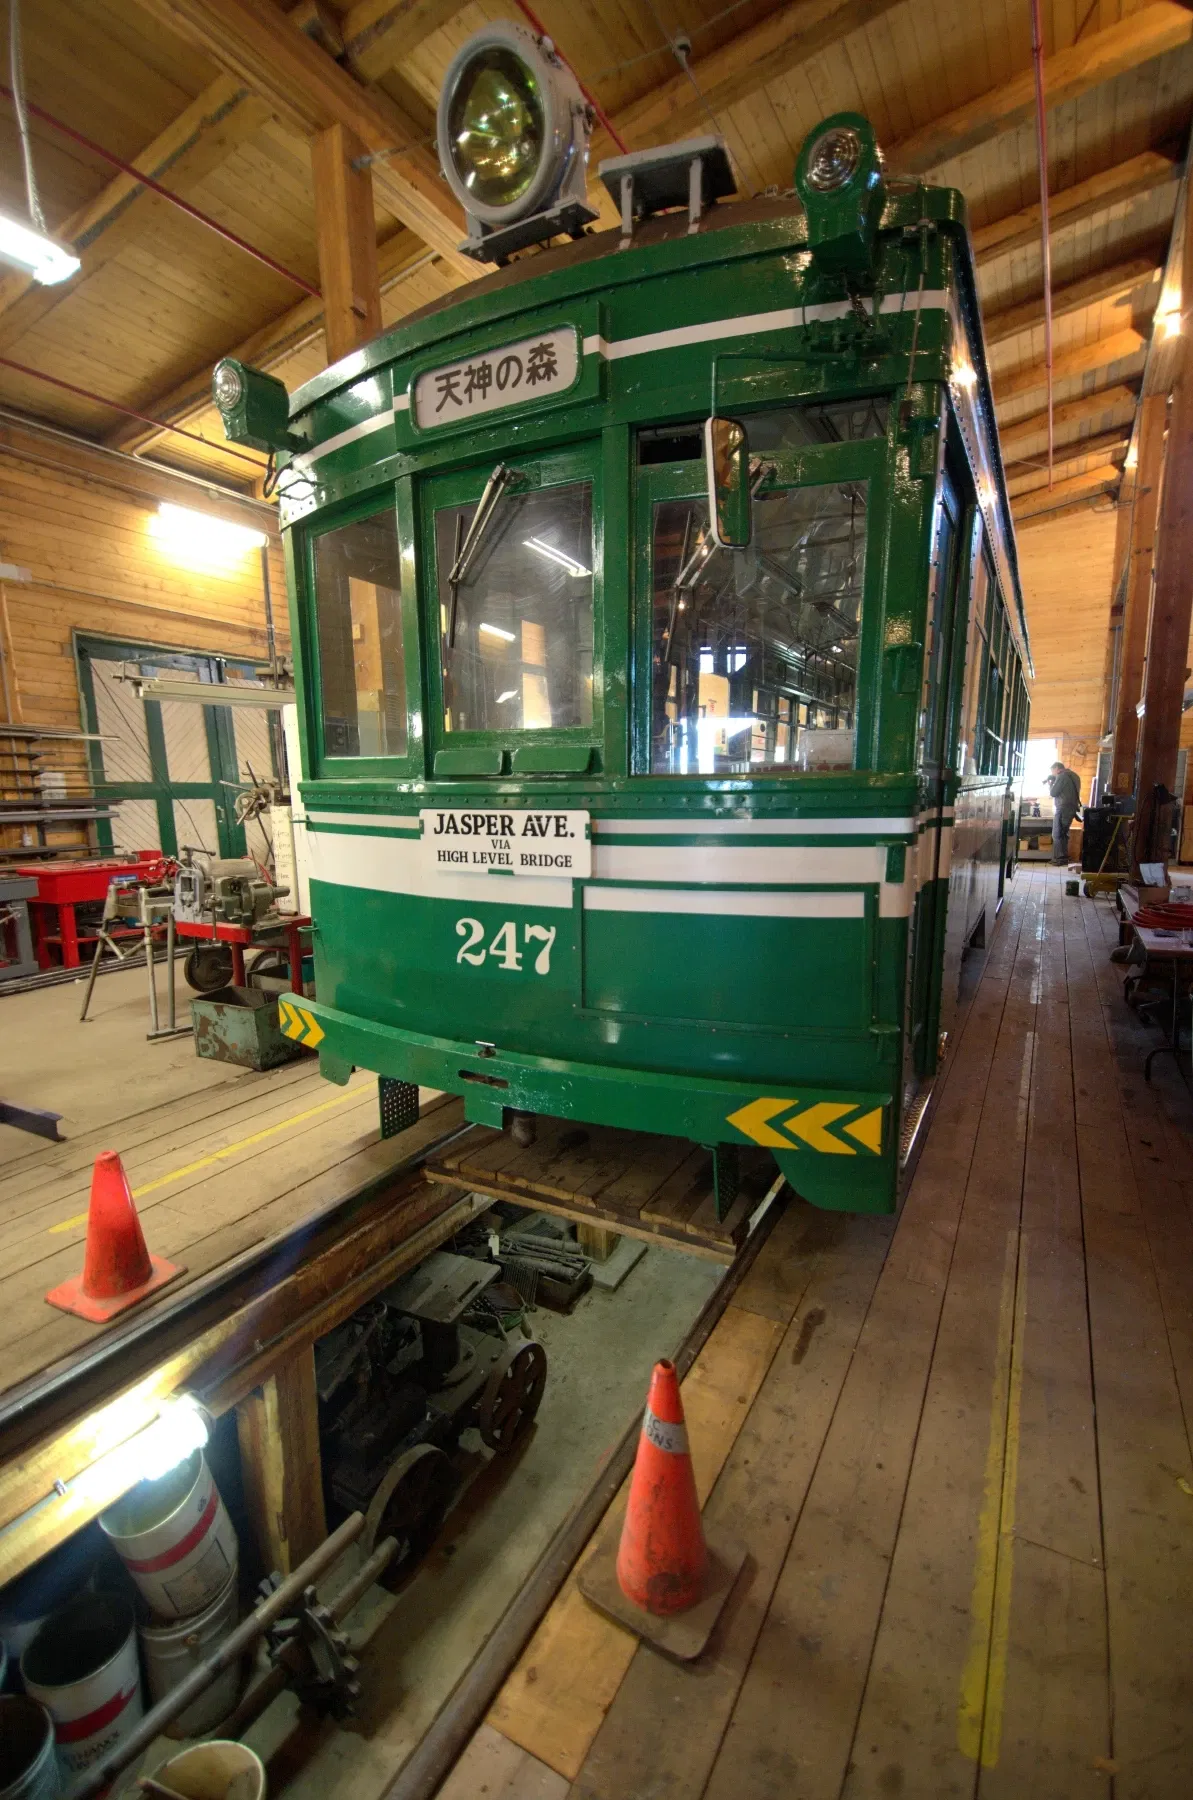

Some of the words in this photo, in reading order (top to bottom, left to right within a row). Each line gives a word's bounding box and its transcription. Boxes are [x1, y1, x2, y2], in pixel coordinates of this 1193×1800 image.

[435, 342, 558, 412] 天神の森
[434, 813, 515, 836] JASPER
[521, 815, 575, 838] AVE.
[491, 839, 511, 850] VIA
[437, 850, 468, 863] HIGH
[473, 852, 513, 865] LEVEL
[520, 854, 572, 868] BRIDGE
[455, 917, 556, 975] 247
